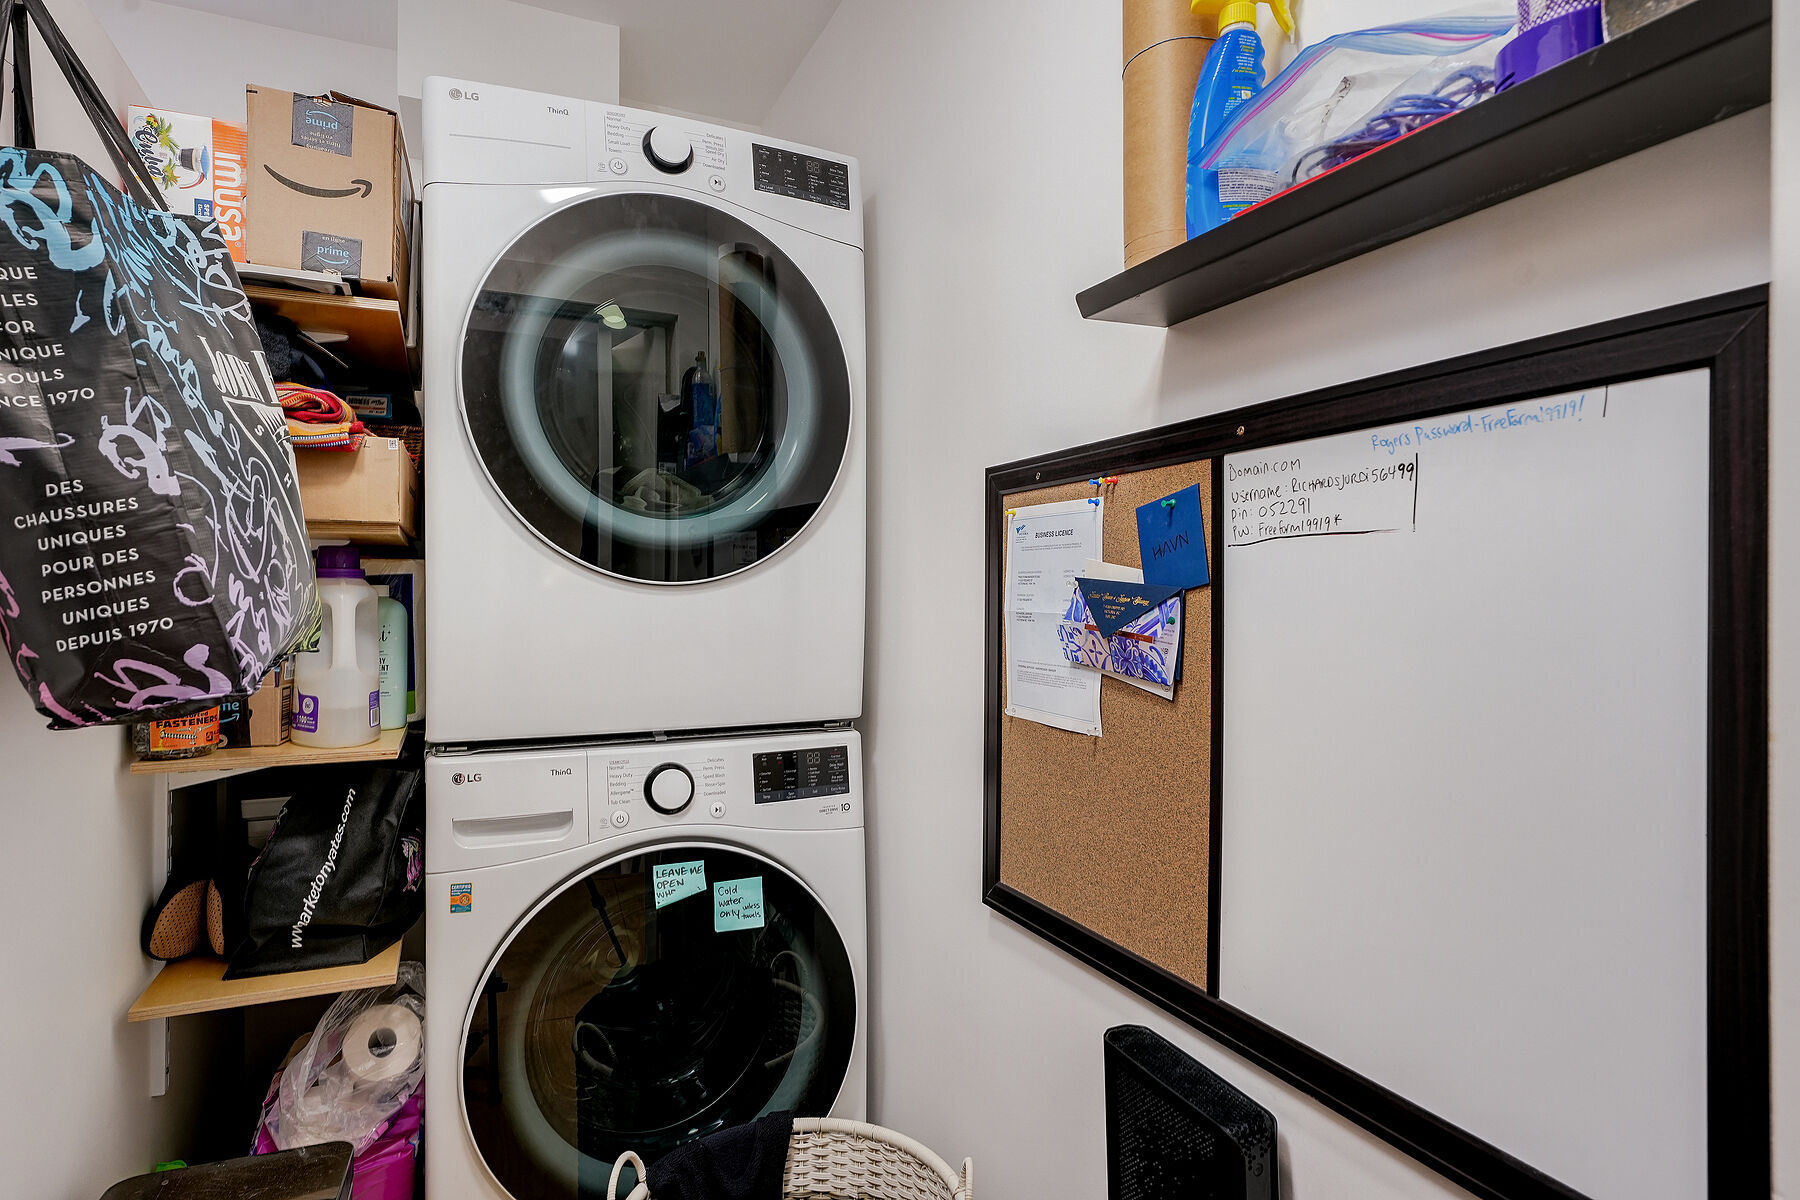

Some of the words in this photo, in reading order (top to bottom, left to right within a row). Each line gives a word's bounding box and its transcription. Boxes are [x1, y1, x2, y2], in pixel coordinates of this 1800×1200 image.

[465, 91, 480, 101] LG
[546, 106, 569, 116] ThinQ
[305, 116, 338, 130] prime
[316, 246, 350, 258] prime
[48, 387, 95, 406] 1970
[44, 479, 84, 498] DES
[14, 497, 140, 530] CHAUSSURES
[1258, 497, 1312, 518] 052291
[37, 524, 127, 551] UNIQUES
[41, 555, 96, 578] POUR
[102, 548, 140, 567] DES
[41, 570, 156, 604] PERSONNES
[62, 596, 150, 626] UNIQUES
[55, 627, 124, 653] DEPUIS
[128, 617, 174, 638] 1970
[156, 714, 218, 729] FASTENERS
[467, 773, 482, 783] LG
[550, 768, 572, 776] ThinQ
[840, 802, 850, 812] 10
[656, 866, 688, 879] LEAVE
[690, 864, 703, 874] ME
[656, 878, 685, 889] OPEN
[717, 884, 738, 896] Cold
[718, 896, 744, 908] water
[742, 902, 761, 911] unless
[719, 908, 741, 920] only
